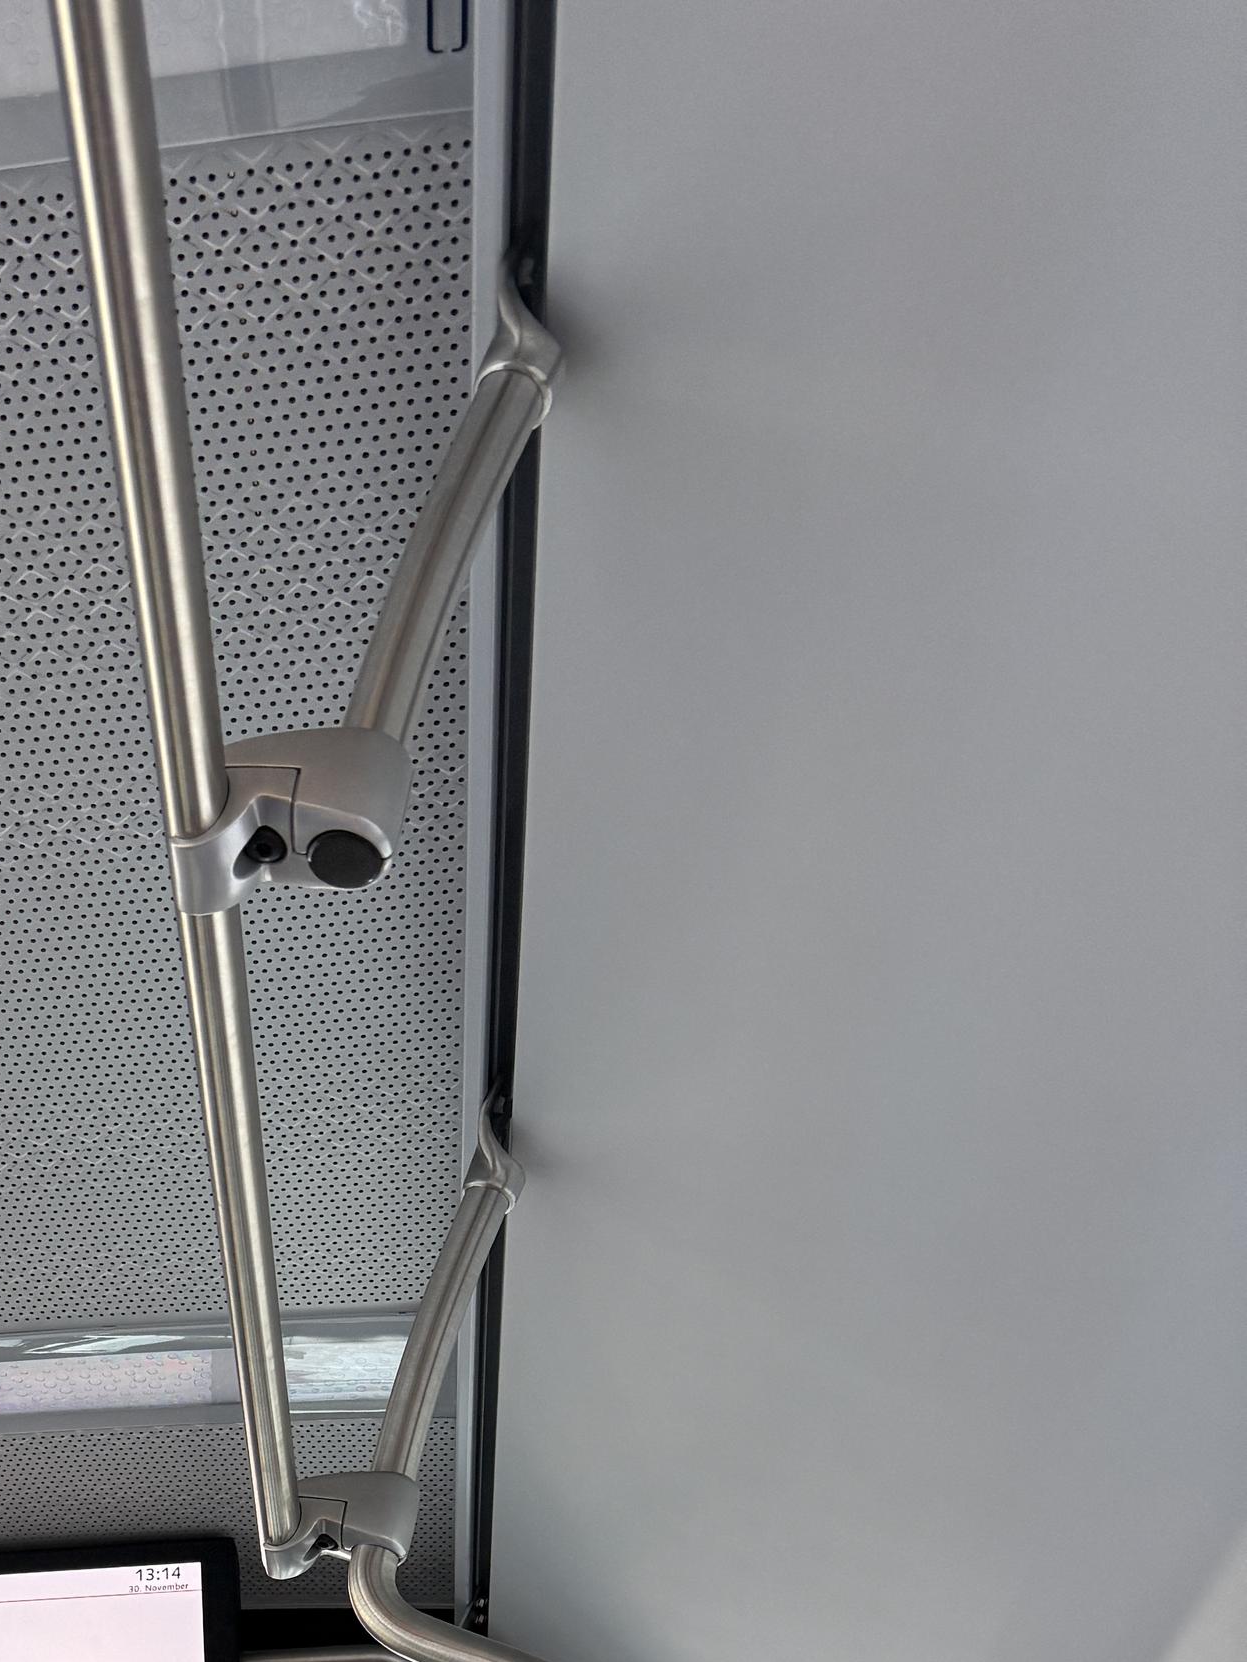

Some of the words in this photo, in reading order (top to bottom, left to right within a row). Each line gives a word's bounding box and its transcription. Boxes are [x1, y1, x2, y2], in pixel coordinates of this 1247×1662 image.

[136, 1566, 181, 1581] 13:14
[128, 1585, 142, 1593] 30.
[145, 1582, 189, 1591] November
